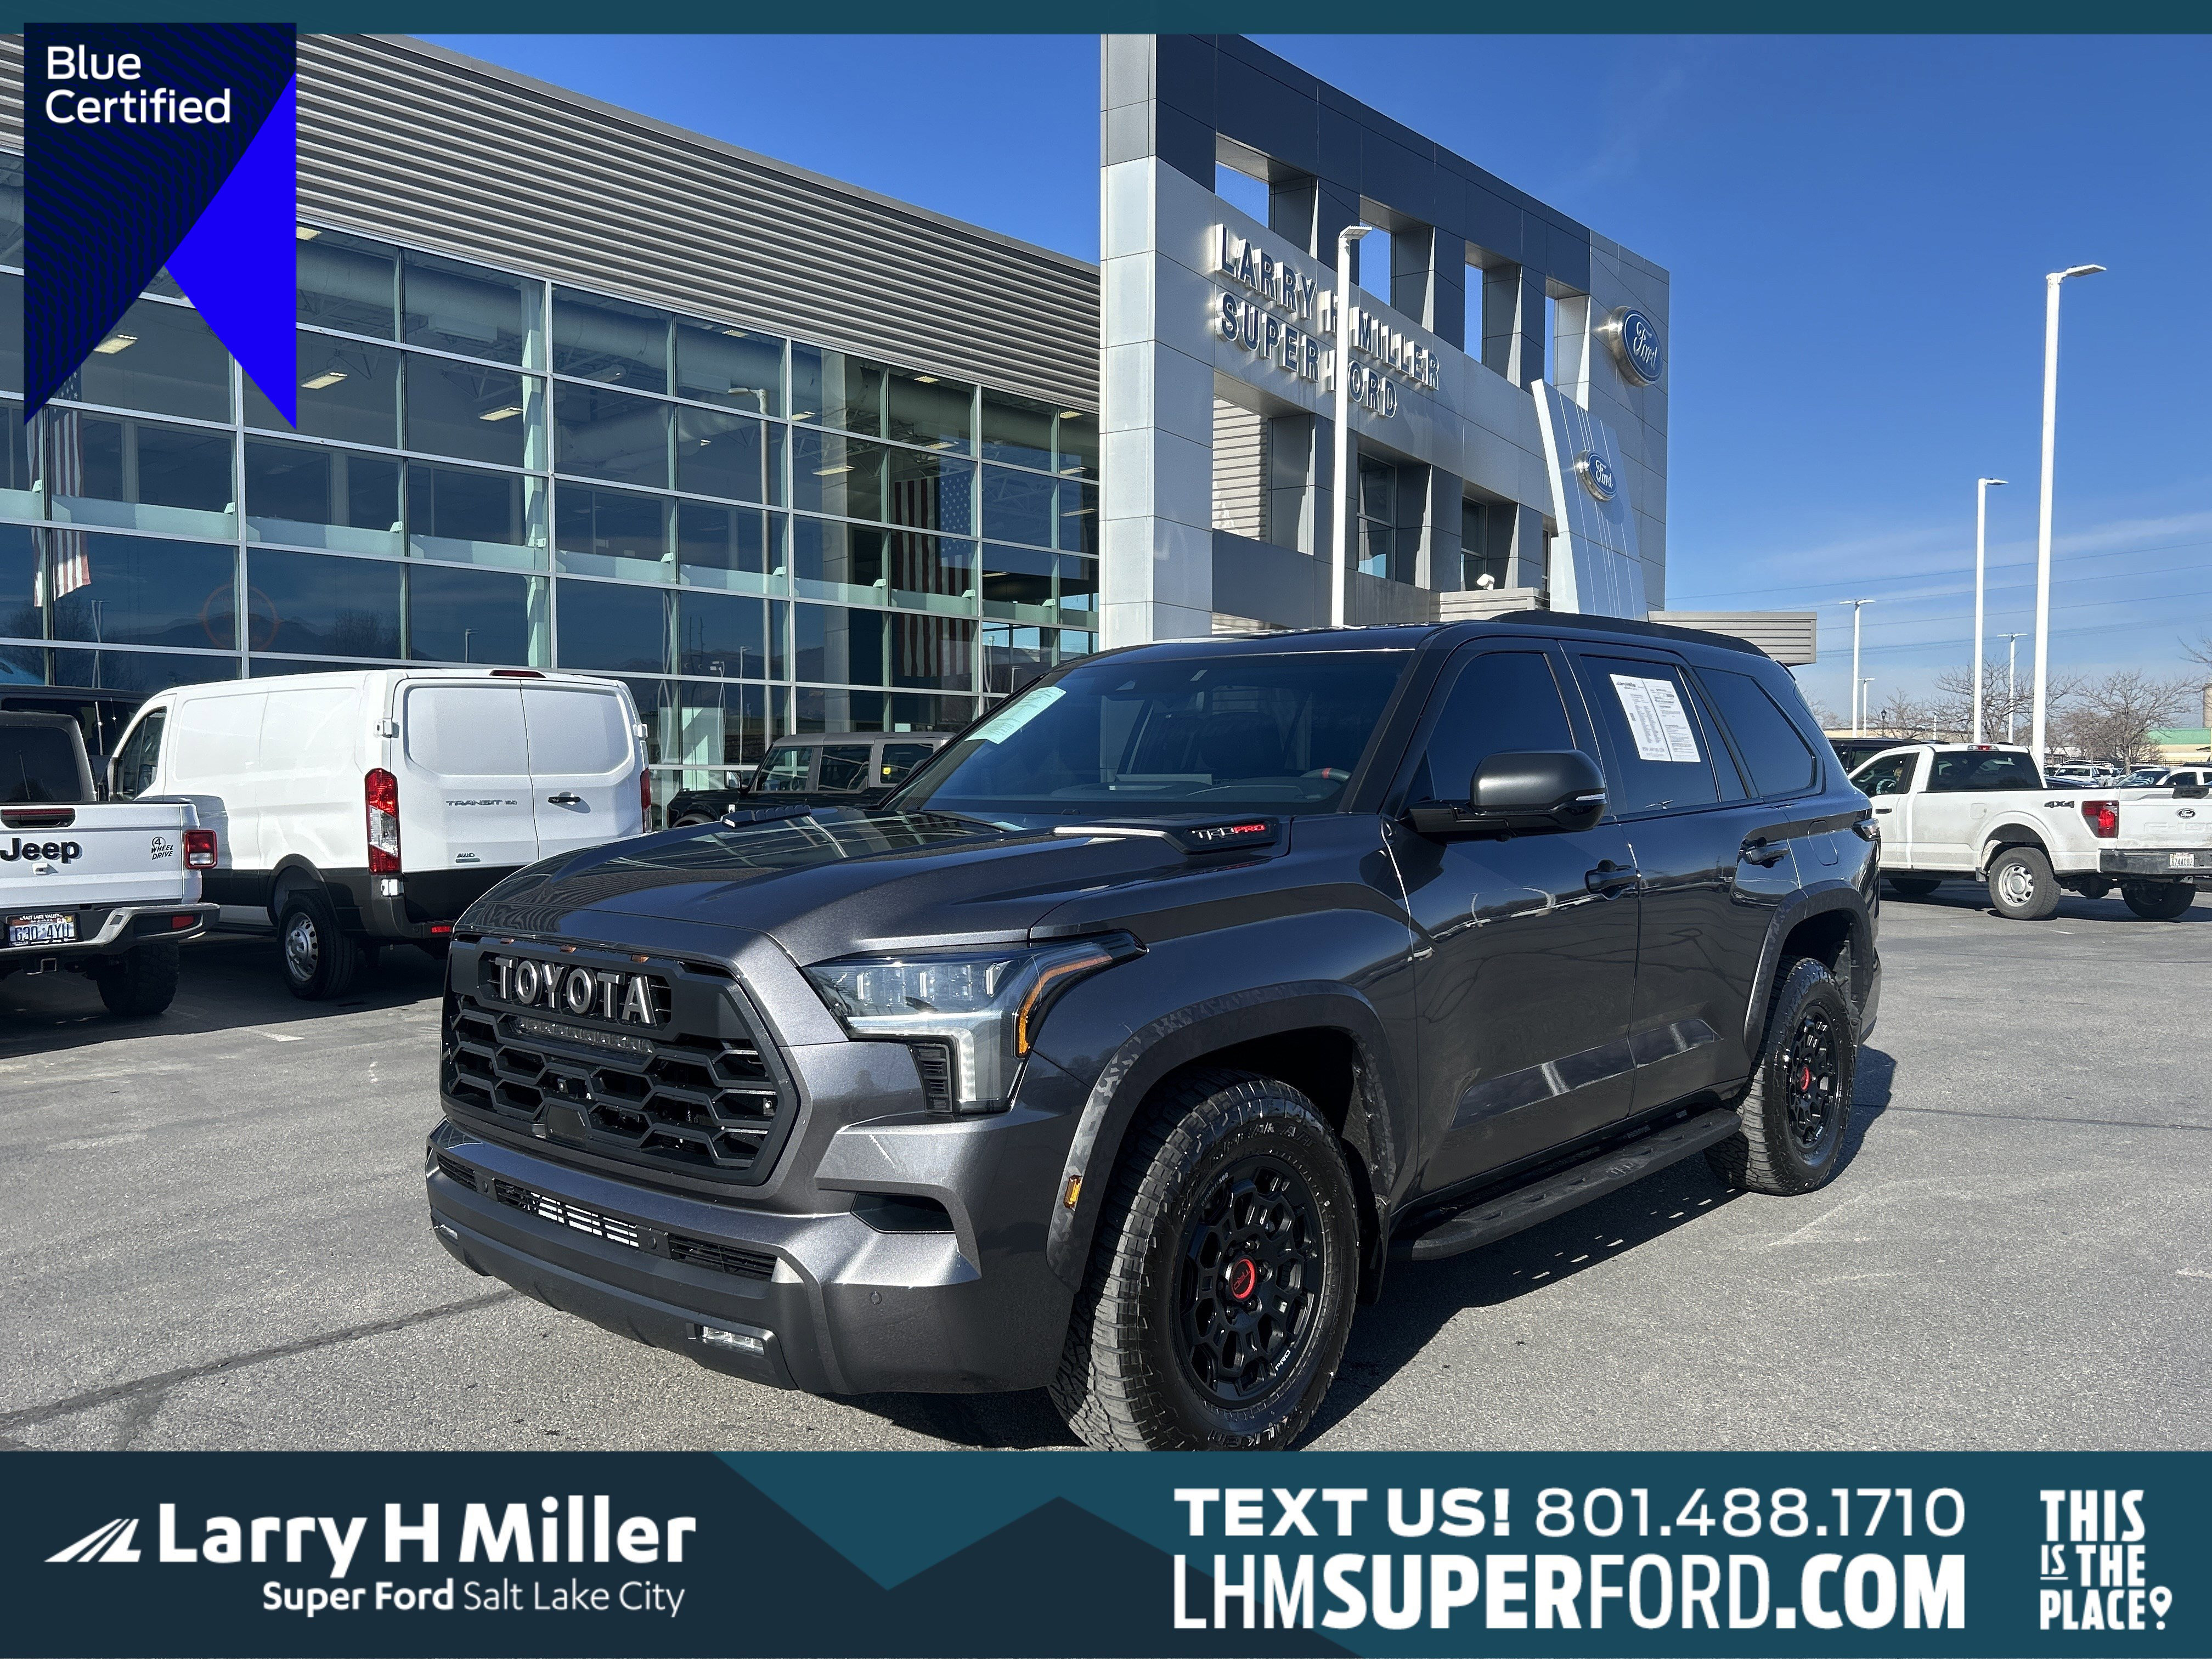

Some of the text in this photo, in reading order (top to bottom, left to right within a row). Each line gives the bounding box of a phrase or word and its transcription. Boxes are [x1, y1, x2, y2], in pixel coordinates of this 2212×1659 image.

[1215, 223, 1316, 320] LARRY
[1350, 307, 1440, 391] MILLER
[1215, 292, 1319, 383] SUPER
[1633, 321, 1658, 369] Ford
[1595, 459, 1613, 489] Ford
[0, 837, 80, 864] Jeep
[151, 844, 173, 854] WHEEL
[152, 851, 173, 860] DRIVE
[495, 956, 658, 1025] TOYOTA
[1274, 1349, 1291, 1371] PRO
